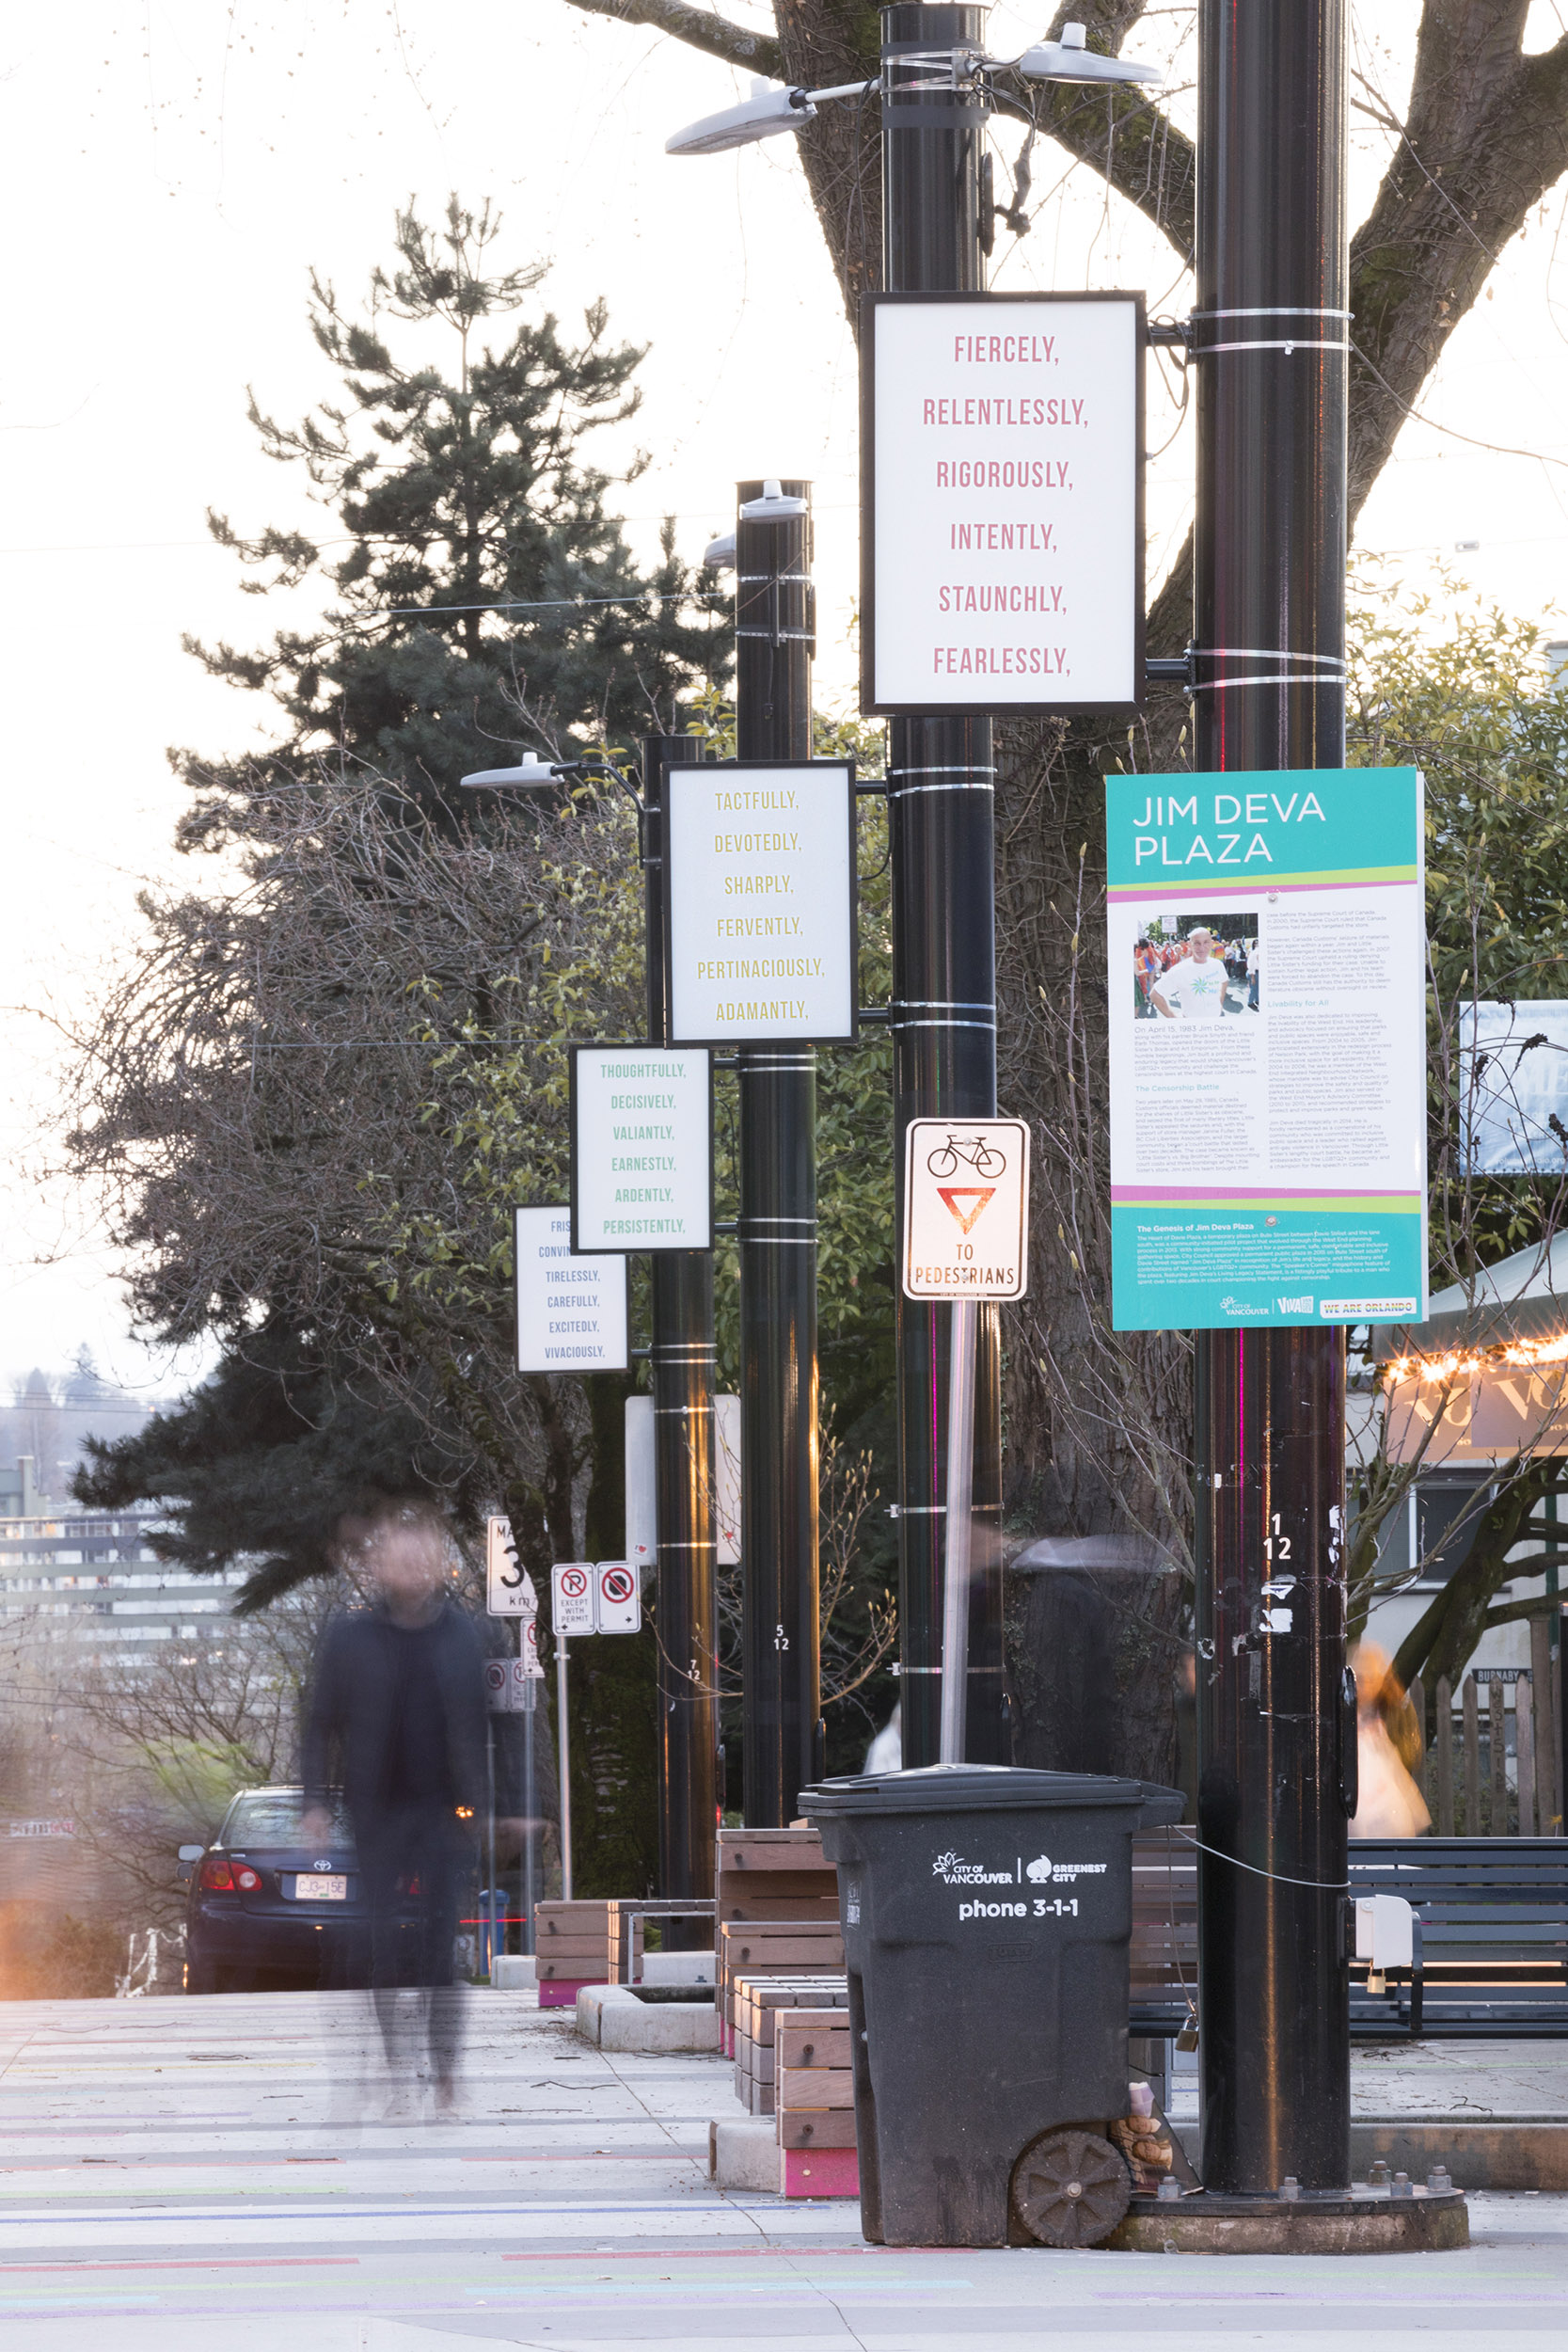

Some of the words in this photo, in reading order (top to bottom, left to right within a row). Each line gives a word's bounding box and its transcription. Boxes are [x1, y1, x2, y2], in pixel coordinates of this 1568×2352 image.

[955, 336, 1058, 366] FIERCELY,
[924, 399, 1087, 428] RELENTLESSLY,
[937, 461, 1072, 491] RIGOROUSLY,
[951, 524, 1056, 553] INTENTLY,
[940, 586, 1067, 615] STAUNCHLY,
[934, 648, 1070, 676] FEARLESSLY,
[715, 791, 799, 810] TACTFULLY,
[1132, 796, 1197, 827] JIM
[1214, 792, 1326, 824] DEVA
[715, 833, 801, 852] DEVOTEDLY,
[1135, 834, 1273, 866] PLAZA
[725, 875, 793, 894] SHARPLY,
[718, 917, 802, 937] FERVENTLY,
[698, 959, 824, 978] PERTINACIOUSLY,
[716, 1001, 808, 1021] ADAMANTLY,
[1267, 1000, 1302, 1009] Livability
[601, 1064, 686, 1078] THOUGHTFULLY,
[1151, 1084, 1194, 1093] Censorship
[611, 1095, 676, 1109] DECISIVELY,
[613, 1126, 674, 1140] VALIANTLY,
[612, 1157, 676, 1171] EARNESTLY,
[615, 1188, 673, 1202] ARDENTLY,
[604, 1219, 685, 1233] PERSISTENTLY,
[957, 1245, 973, 1260] TO
[546, 1270, 600, 1282] TIRELESSLY,
[916, 1267, 1014, 1284] PEDESTRIANS
[548, 1295, 599, 1308] CAREFULLY,
[1324, 1304, 1339, 1313] WE
[1343, 1304, 1361, 1312] ARE
[1366, 1302, 1412, 1312] ORLANDO
[549, 1321, 599, 1333] EXCITEDLY,
[545, 1346, 605, 1359] VIVACIOUSLY,
[497, 1525, 514, 1538] MA
[1272, 1514, 1280, 1535] 1
[1263, 1537, 1291, 1560] 12
[500, 1546, 524, 1588] 3
[777, 1625, 784, 1636] 5
[774, 1639, 789, 1650] 12
[690, 1660, 697, 1669] 7
[953, 1866, 971, 1874] CITY
[973, 1865, 984, 1874] OF
[1052, 1864, 1107, 1874] GREENEST
[942, 1873, 1012, 1884] VANCOUVER
[1053, 1872, 1077, 1883] CITY
[959, 1899, 1027, 1921] phone
[1033, 1899, 1078, 1916] 3-1-1
